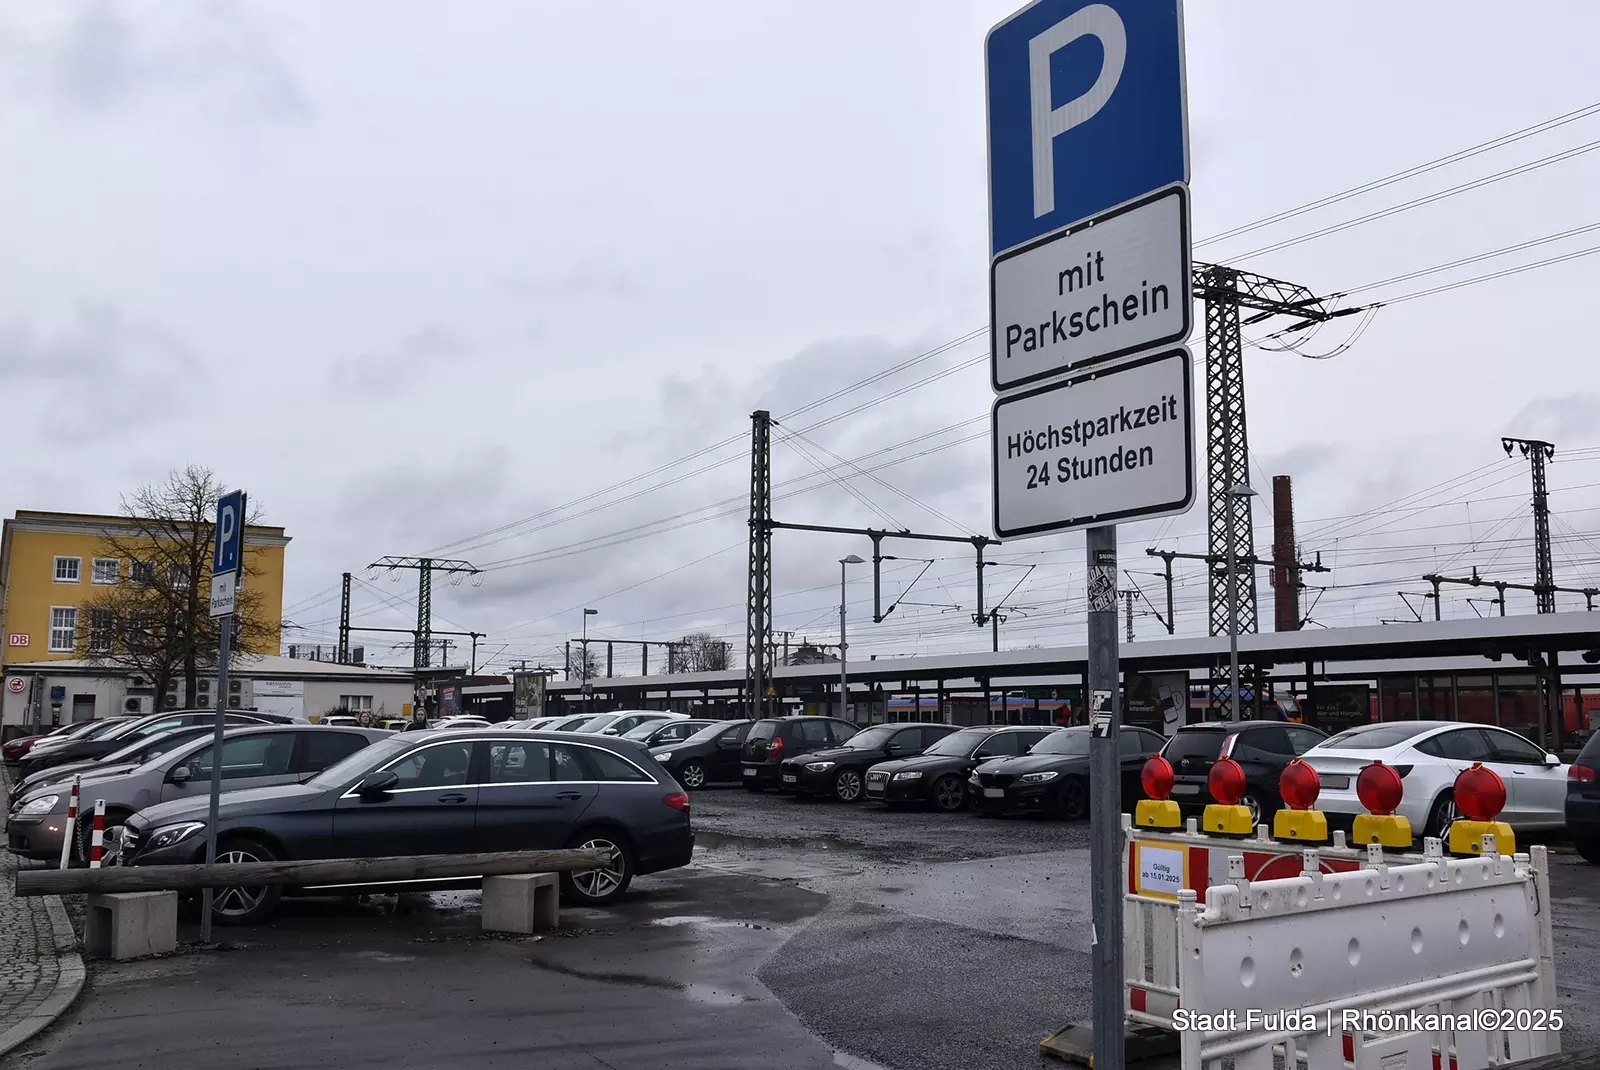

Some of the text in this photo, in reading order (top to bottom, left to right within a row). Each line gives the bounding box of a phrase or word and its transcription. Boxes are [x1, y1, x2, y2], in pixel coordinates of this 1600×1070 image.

[1029, 3, 1127, 219] P
[1058, 250, 1105, 296] mit
[1005, 280, 1169, 359] Parkschein
[1007, 394, 1178, 460] Höchstparkzeit
[1026, 445, 1153, 490] 24 Stunden
[218, 505, 235, 566] P
[1094, 588, 1115, 612] CREW
[11, 635, 28, 645] DB
[1150, 872, 1180, 883] 15.01.2025
[1153, 863, 1170, 874] Gültig
